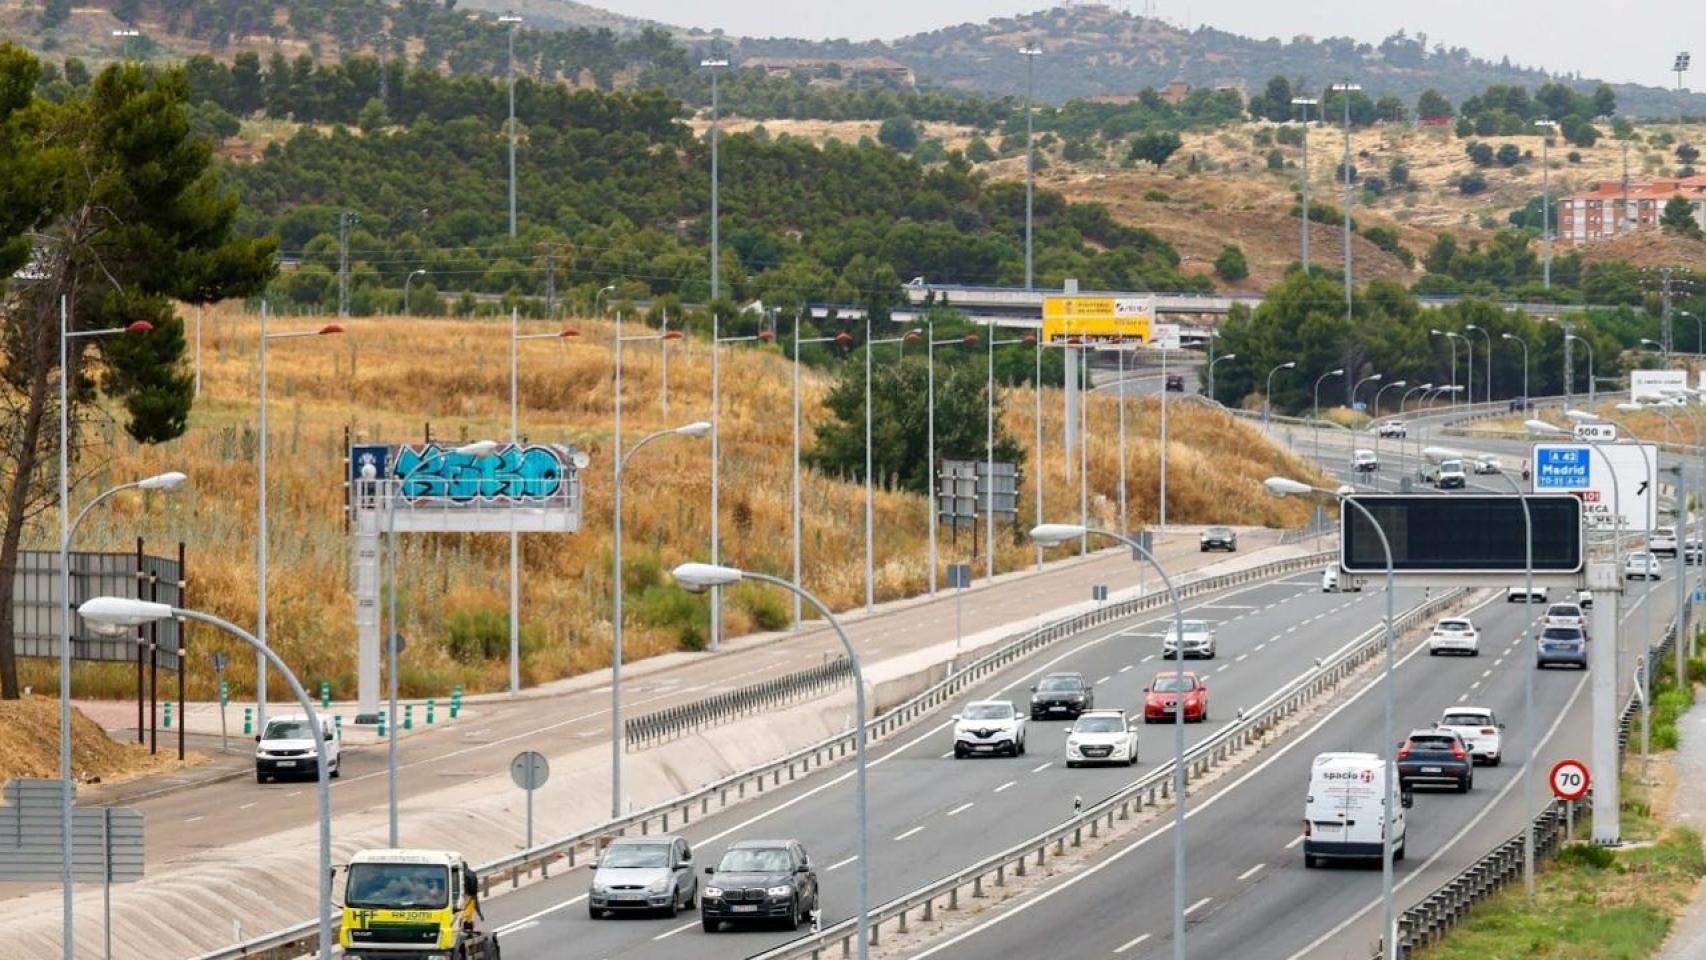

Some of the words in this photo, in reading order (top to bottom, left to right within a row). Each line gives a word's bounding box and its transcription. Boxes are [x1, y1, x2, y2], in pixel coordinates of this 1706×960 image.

[1577, 428, 1599, 437] 500
[1552, 452, 1559, 460] A
[1562, 452, 1575, 460] 42
[1542, 464, 1585, 475] Madrid
[1323, 771, 1358, 780] spacio
[1560, 773, 1580, 786] 70
